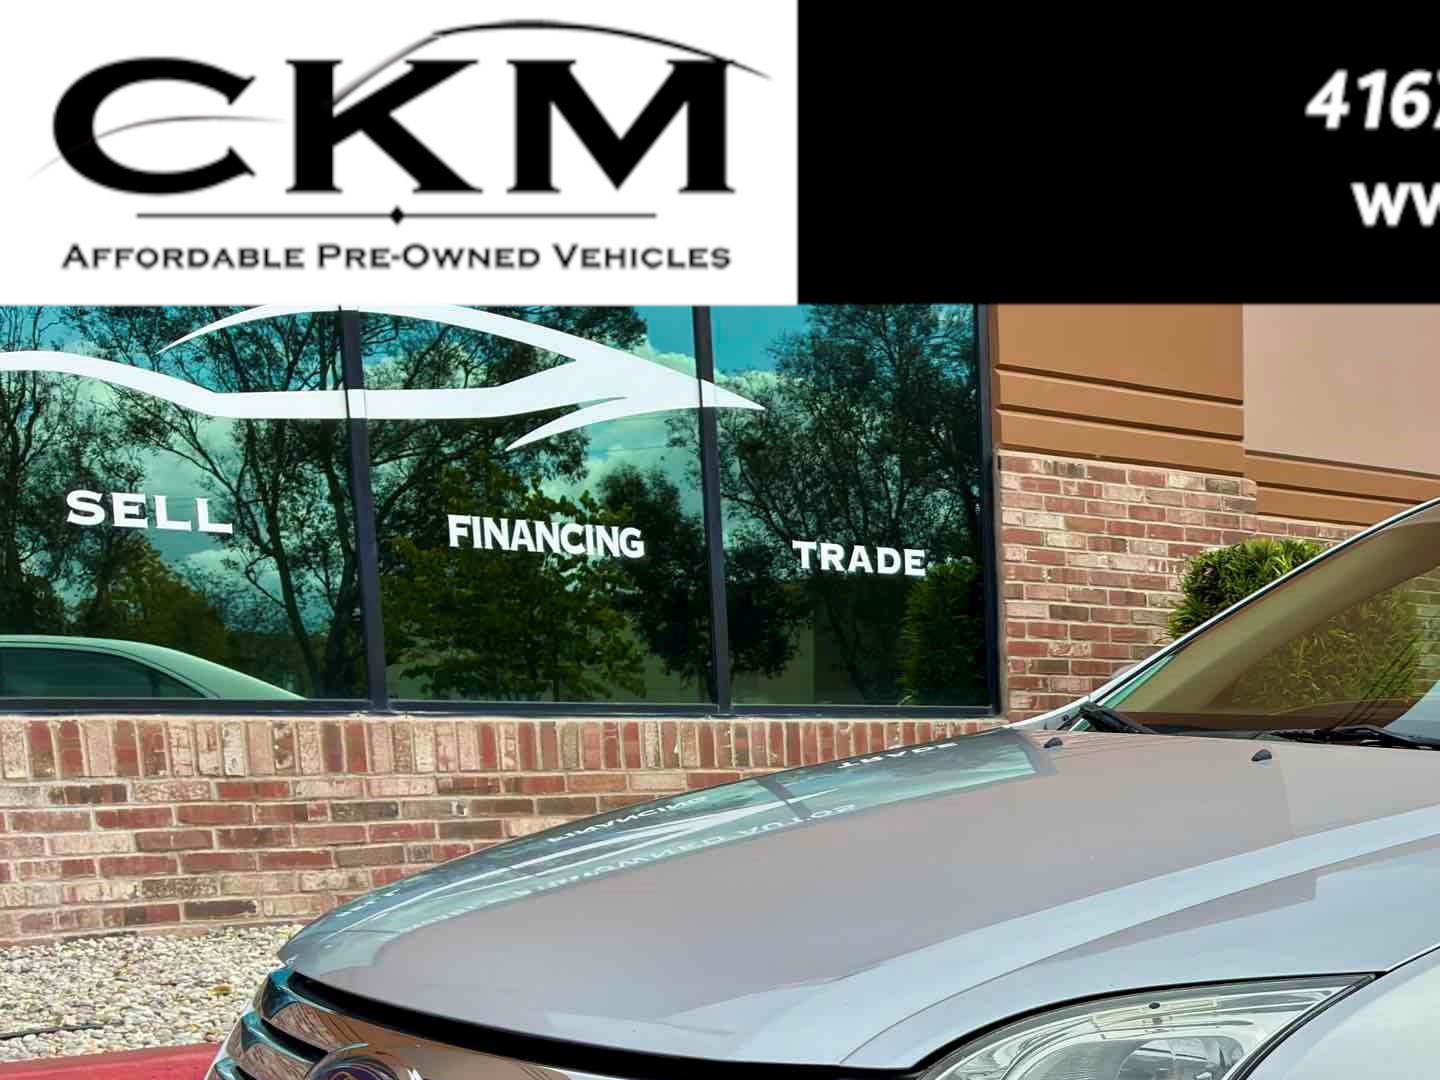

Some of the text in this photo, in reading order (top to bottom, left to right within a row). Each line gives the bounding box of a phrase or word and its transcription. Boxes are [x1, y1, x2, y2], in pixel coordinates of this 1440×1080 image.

[66, 489, 234, 536] SELL
[447, 514, 646, 559] FINANCING
[792, 539, 928, 578] TRADE
